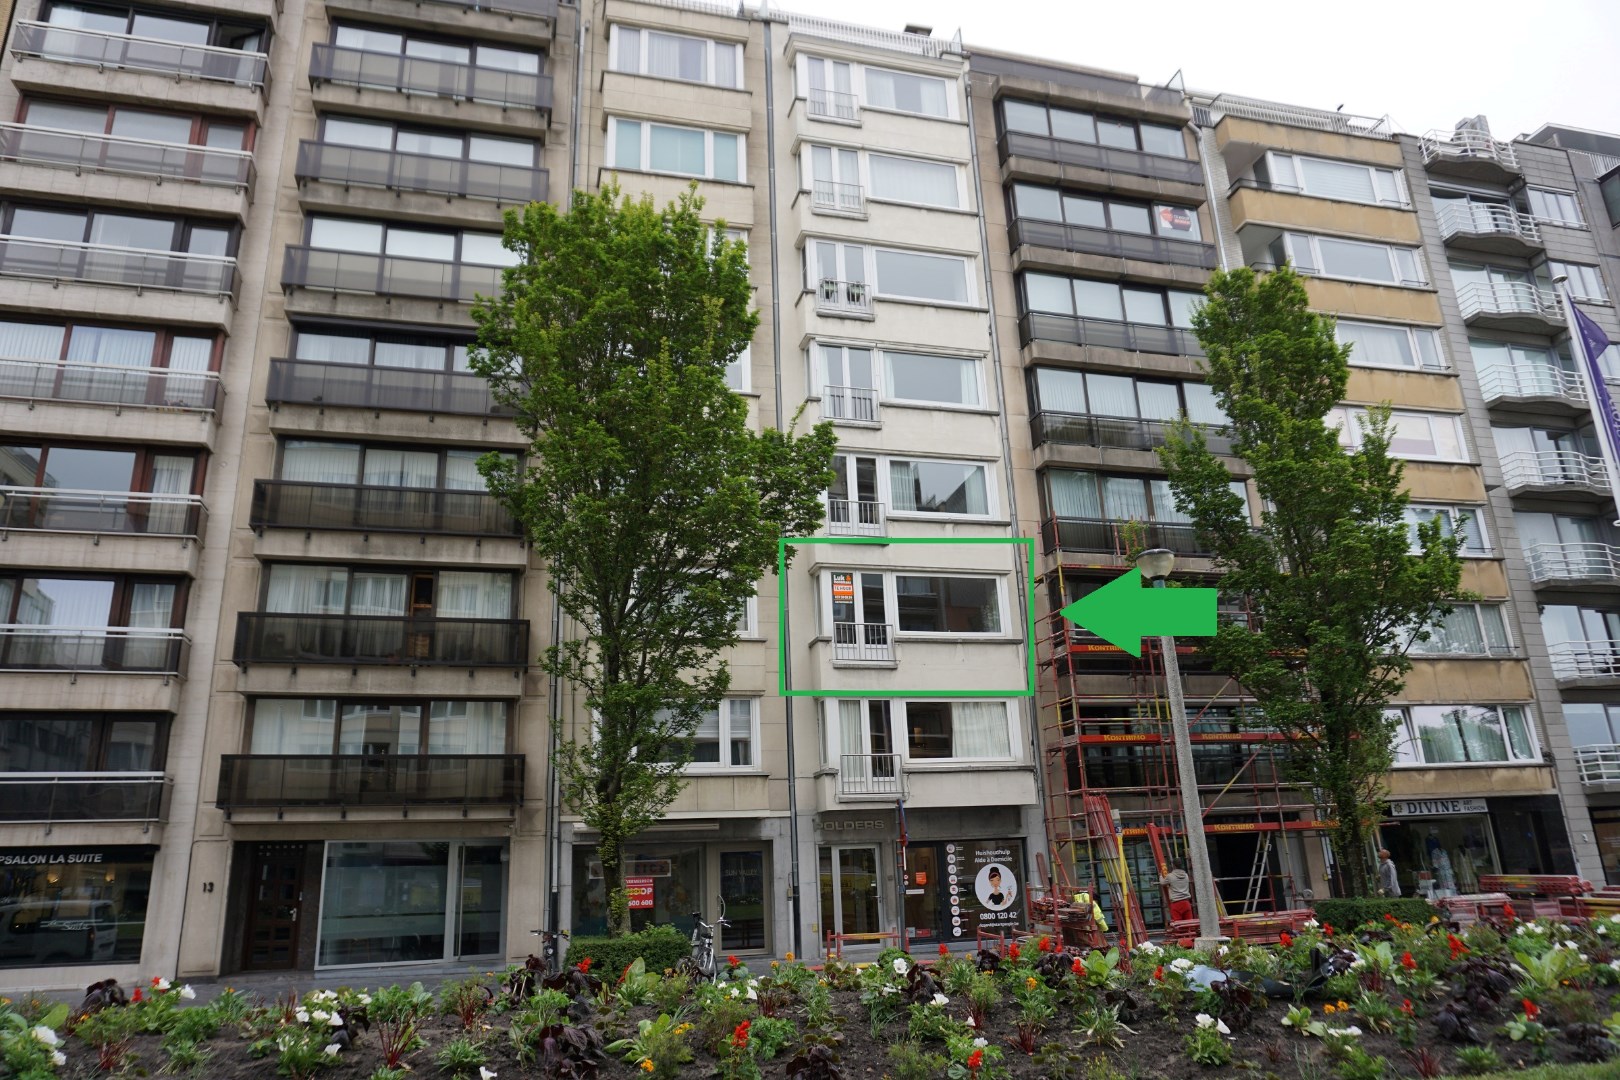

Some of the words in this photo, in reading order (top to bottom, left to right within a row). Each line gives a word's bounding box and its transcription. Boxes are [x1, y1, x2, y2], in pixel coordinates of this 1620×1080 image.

[1407, 800, 1461, 814] DIVINE
[49, 854, 65, 864] LA
[67, 853, 103, 863] SUITE
[202, 882, 214, 893] 13
[979, 912, 996, 920] 0800
[1008, 911, 1018, 919] 42
